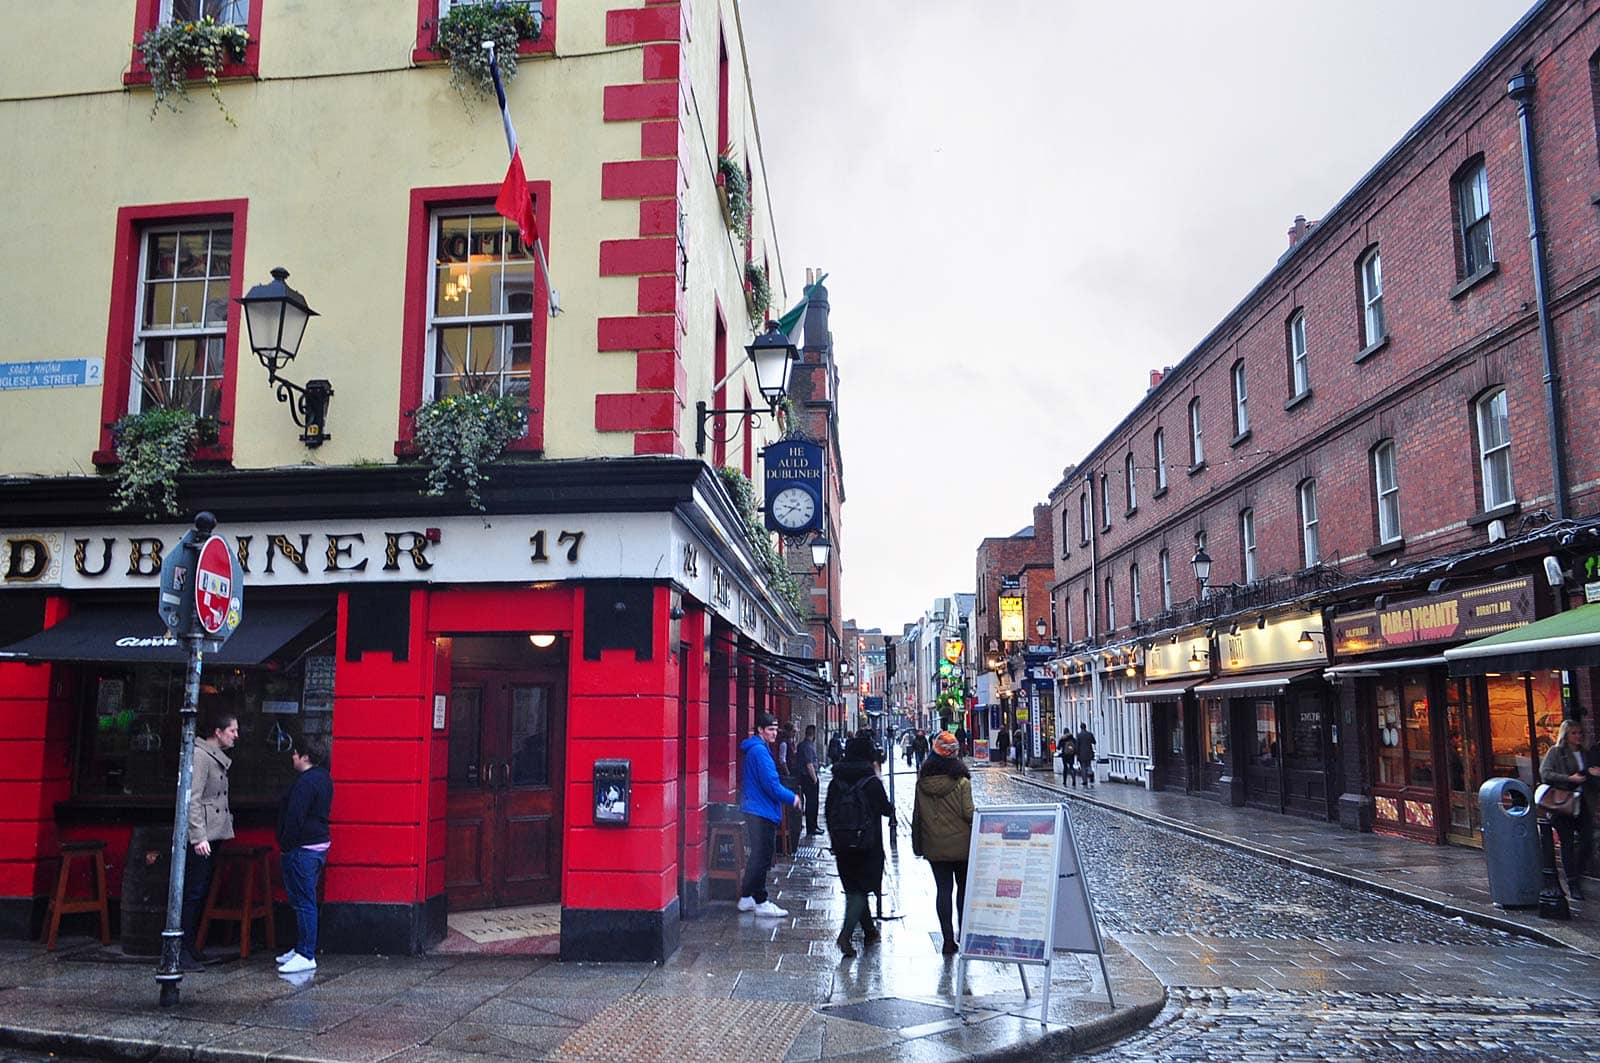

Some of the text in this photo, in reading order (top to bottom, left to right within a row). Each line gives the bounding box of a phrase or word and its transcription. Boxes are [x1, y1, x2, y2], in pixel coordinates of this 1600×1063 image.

[90, 364, 99, 379] 2
[0, 374, 79, 387] GLESEA STREET
[778, 458, 809, 468] AULD
[767, 469, 820, 479] DUBLINER
[529, 530, 585, 564] 17
[4, 531, 433, 581] DUBINER
[1475, 600, 1512, 617] BURRITO BAR
[1380, 600, 1460, 636] PABLO PICANTE
